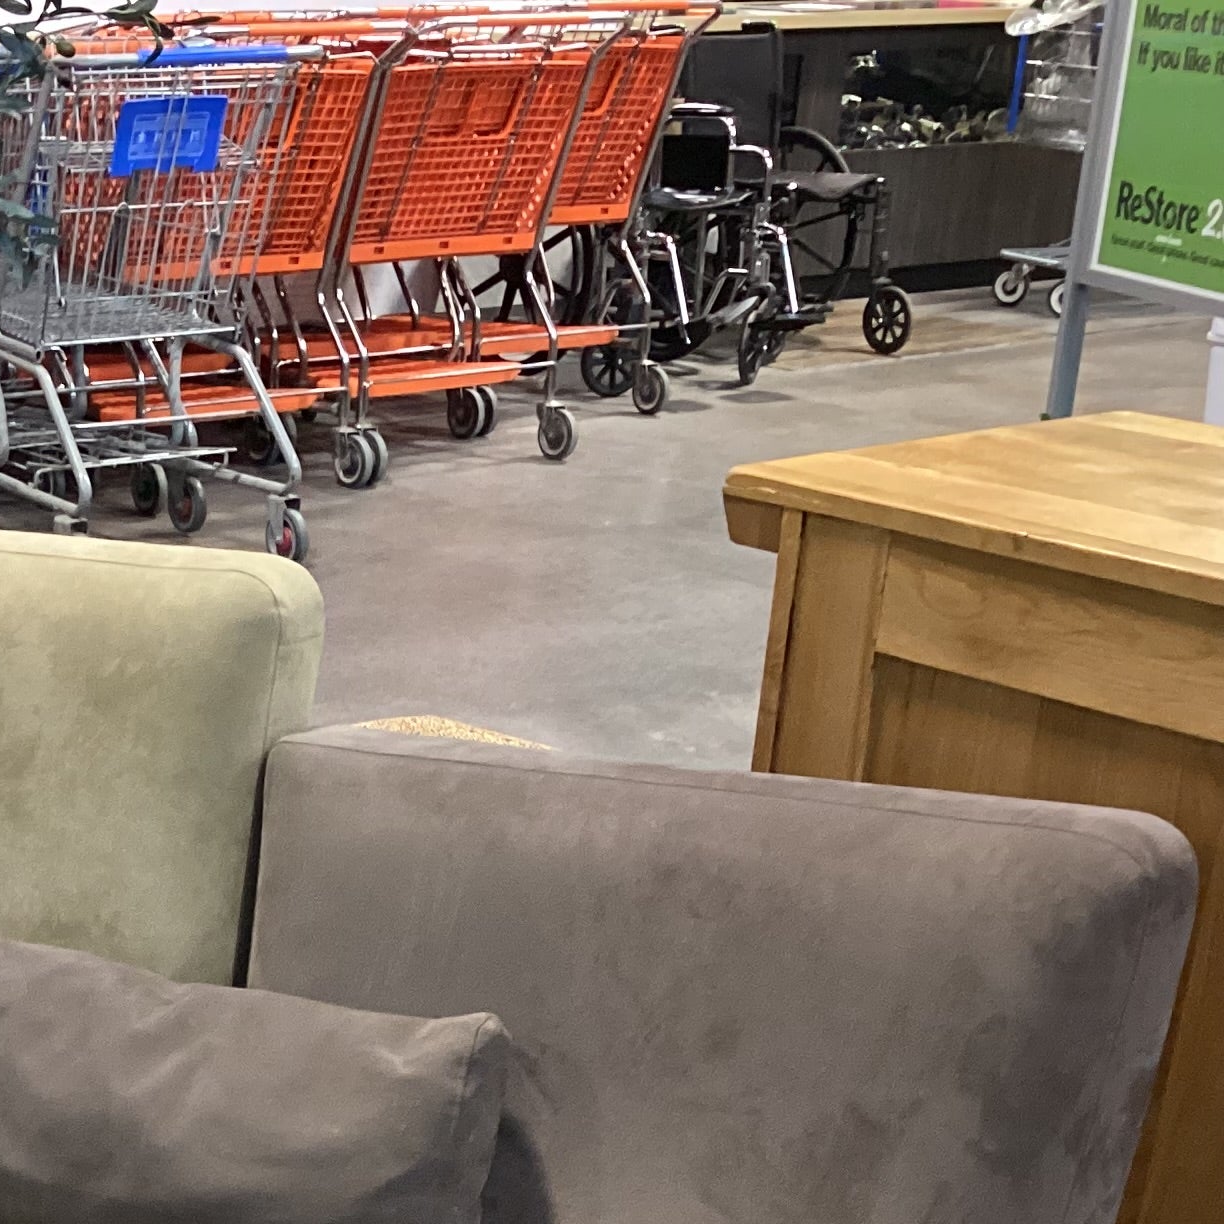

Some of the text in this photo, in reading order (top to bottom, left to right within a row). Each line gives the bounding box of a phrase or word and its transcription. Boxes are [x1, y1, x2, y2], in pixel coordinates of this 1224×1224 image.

[1143, 4, 1189, 30] Moral
[1187, 10, 1210, 32] of
[1137, 41, 1150, 65] If
[1151, 49, 1181, 73] you
[1183, 46, 1211, 73] like
[1115, 180, 1224, 242] ReStore 2.
